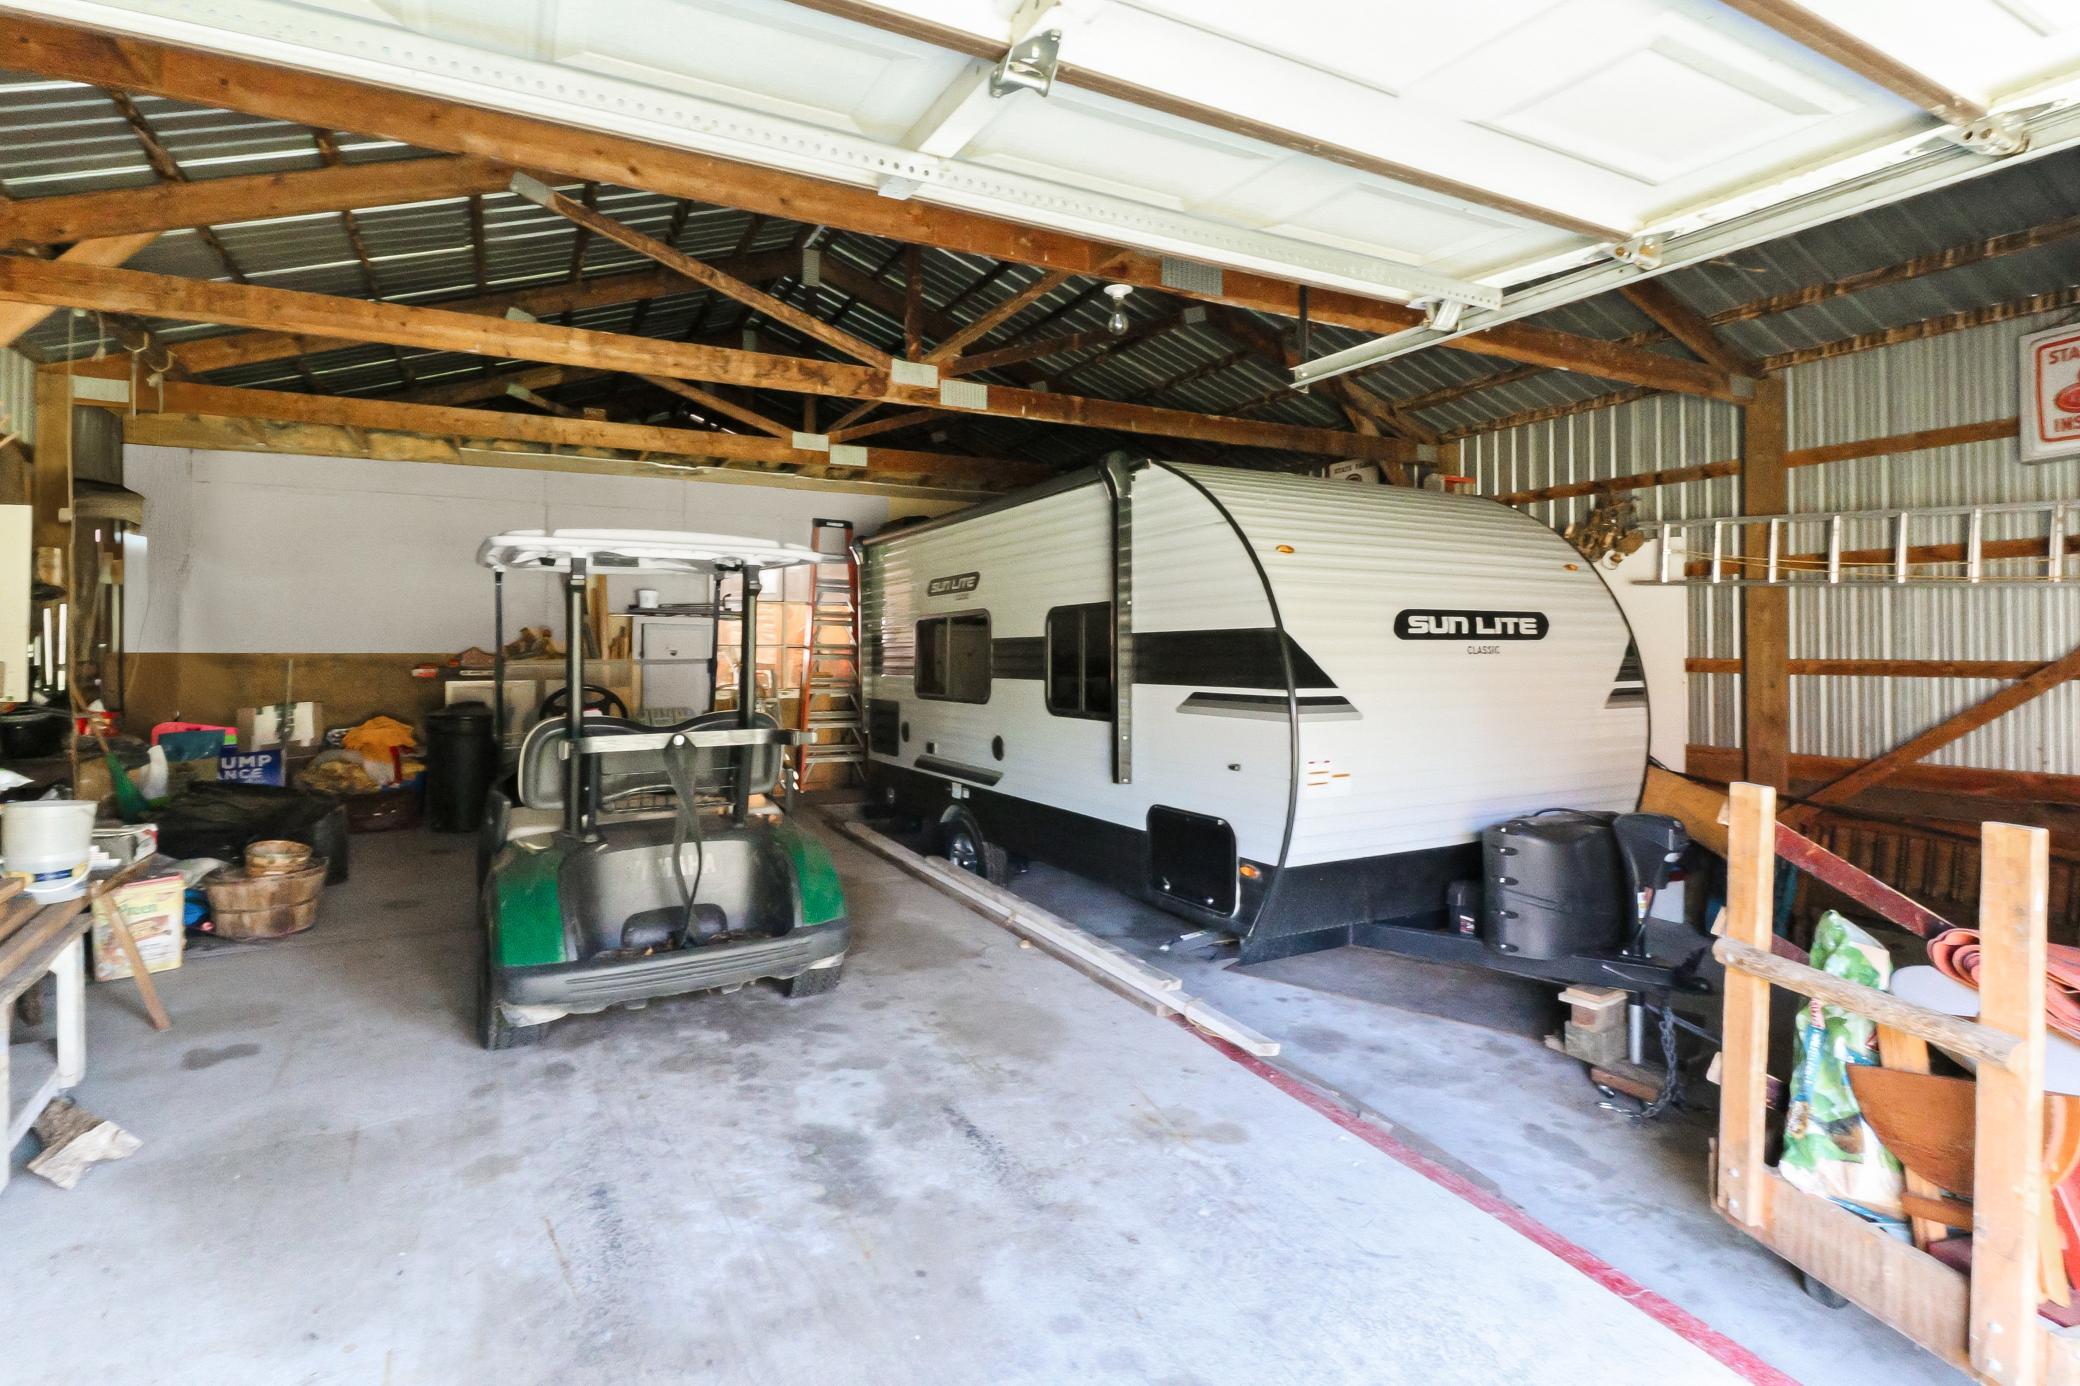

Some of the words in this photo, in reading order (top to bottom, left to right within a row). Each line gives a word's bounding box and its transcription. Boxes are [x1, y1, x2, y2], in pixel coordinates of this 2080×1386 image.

[1407, 616, 1469, 634] SUN
[1476, 617, 1538, 635] LITE
[1467, 646, 1500, 655] CLASSIC
